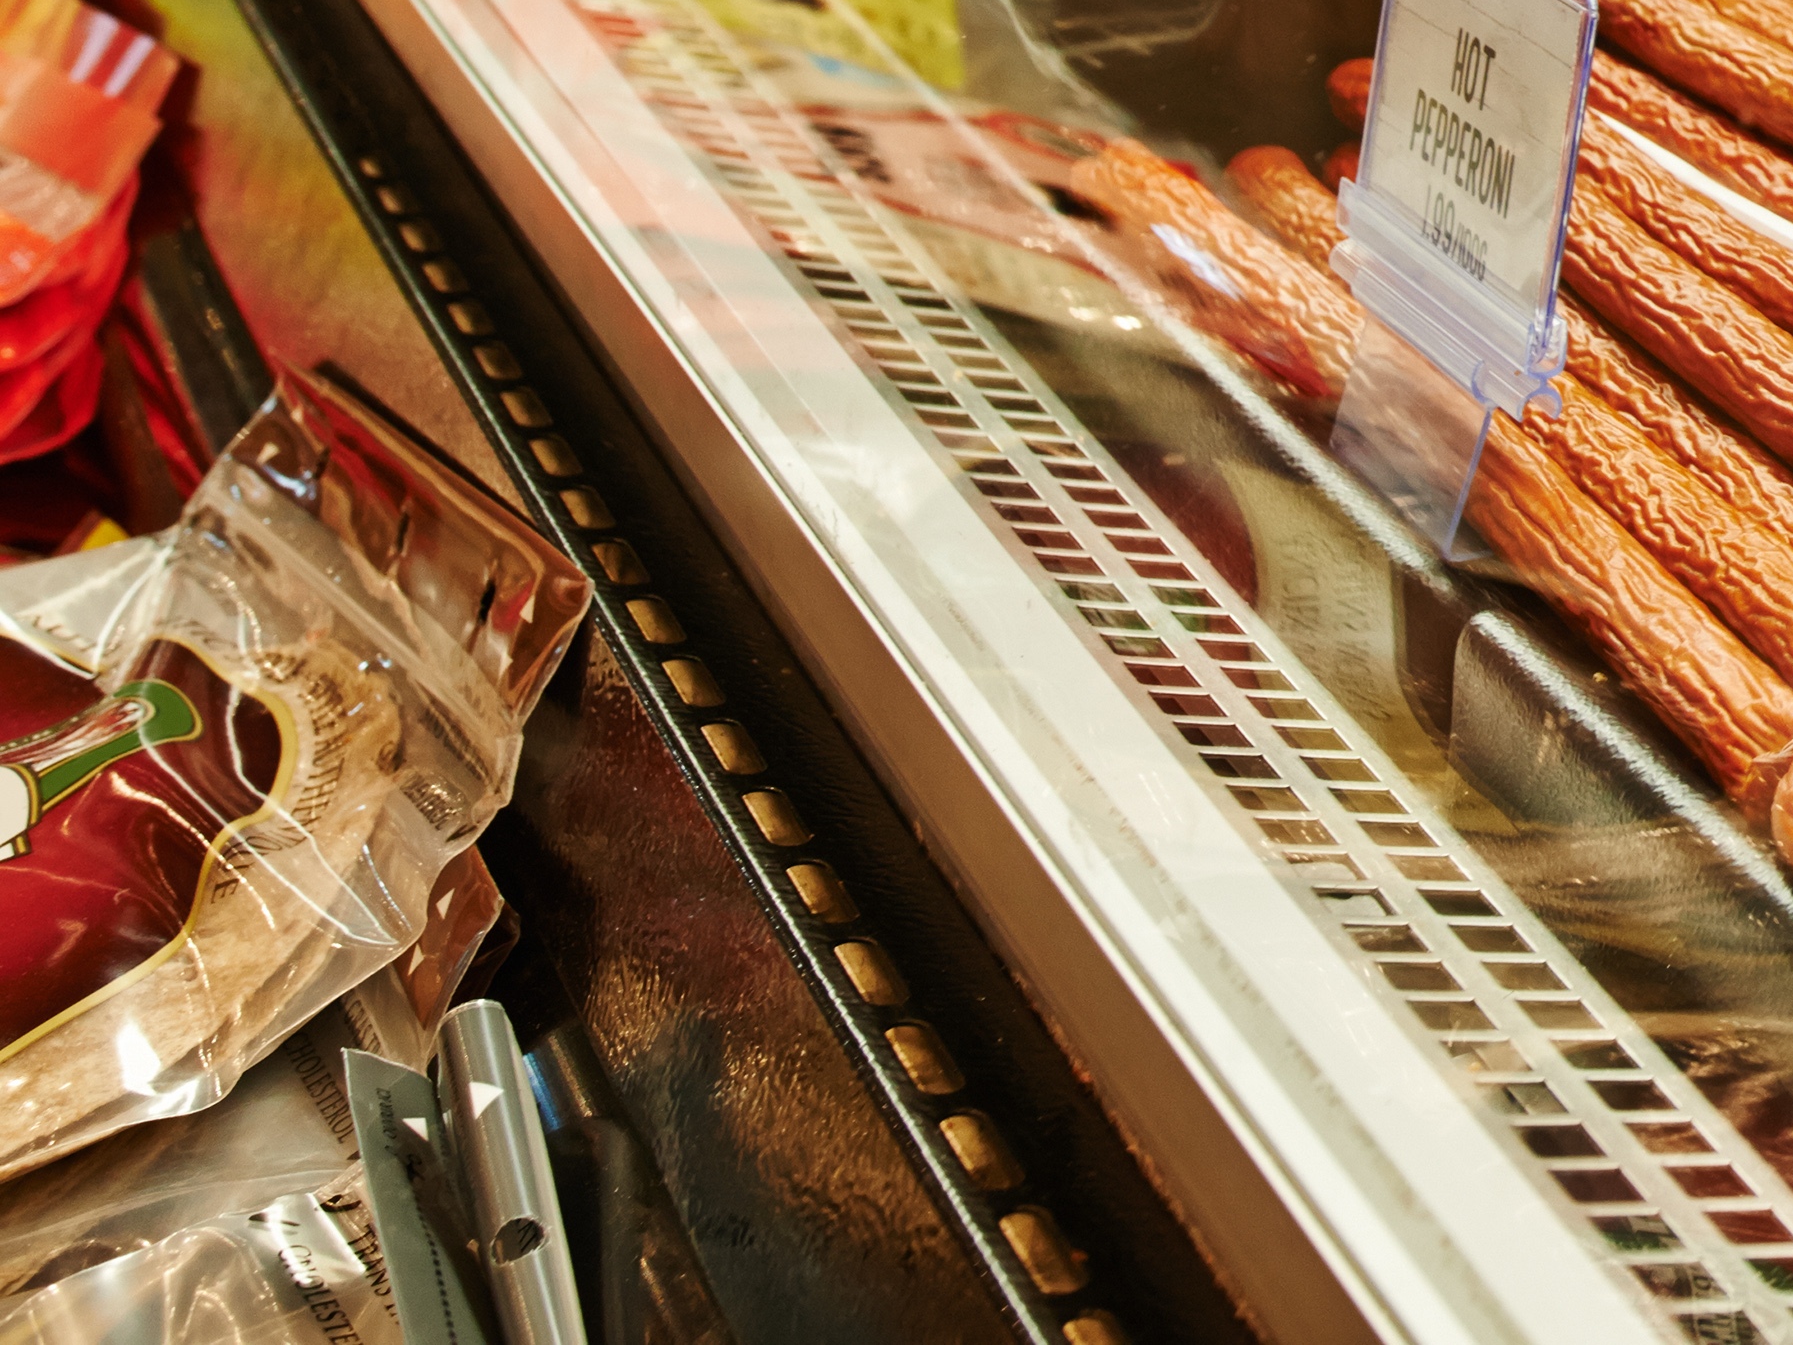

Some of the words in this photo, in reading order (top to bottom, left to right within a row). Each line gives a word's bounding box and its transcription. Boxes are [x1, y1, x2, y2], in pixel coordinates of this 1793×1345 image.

[1450, 27, 1496, 111] HOT
[1409, 89, 1516, 220] PEPPERONI
[277, 1243, 364, 1345] CHOLESTE
